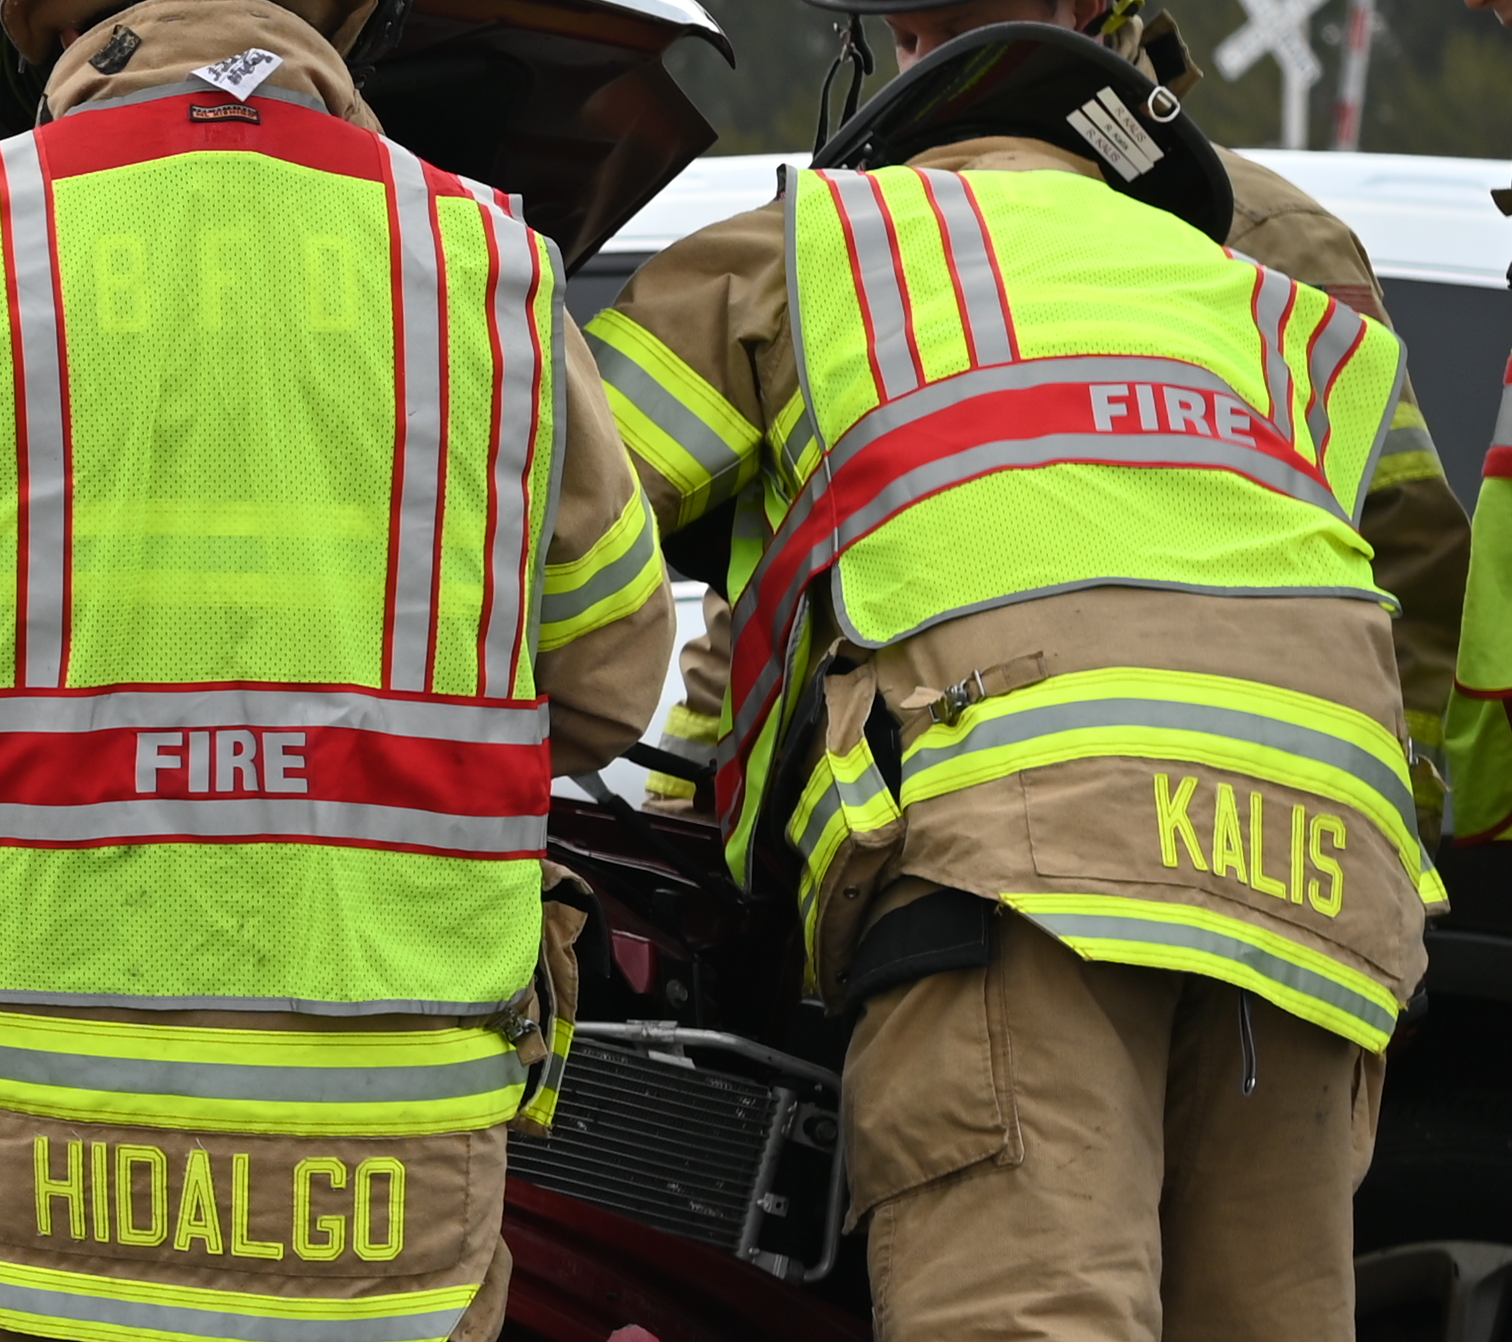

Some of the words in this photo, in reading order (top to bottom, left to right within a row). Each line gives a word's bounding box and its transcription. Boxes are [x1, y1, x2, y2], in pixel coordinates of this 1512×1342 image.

[1089, 384, 1257, 448] FIRE
[136, 729, 308, 793] FIRE
[1154, 773, 1346, 918] KALIS
[34, 1135, 406, 1261] HIDALGO
